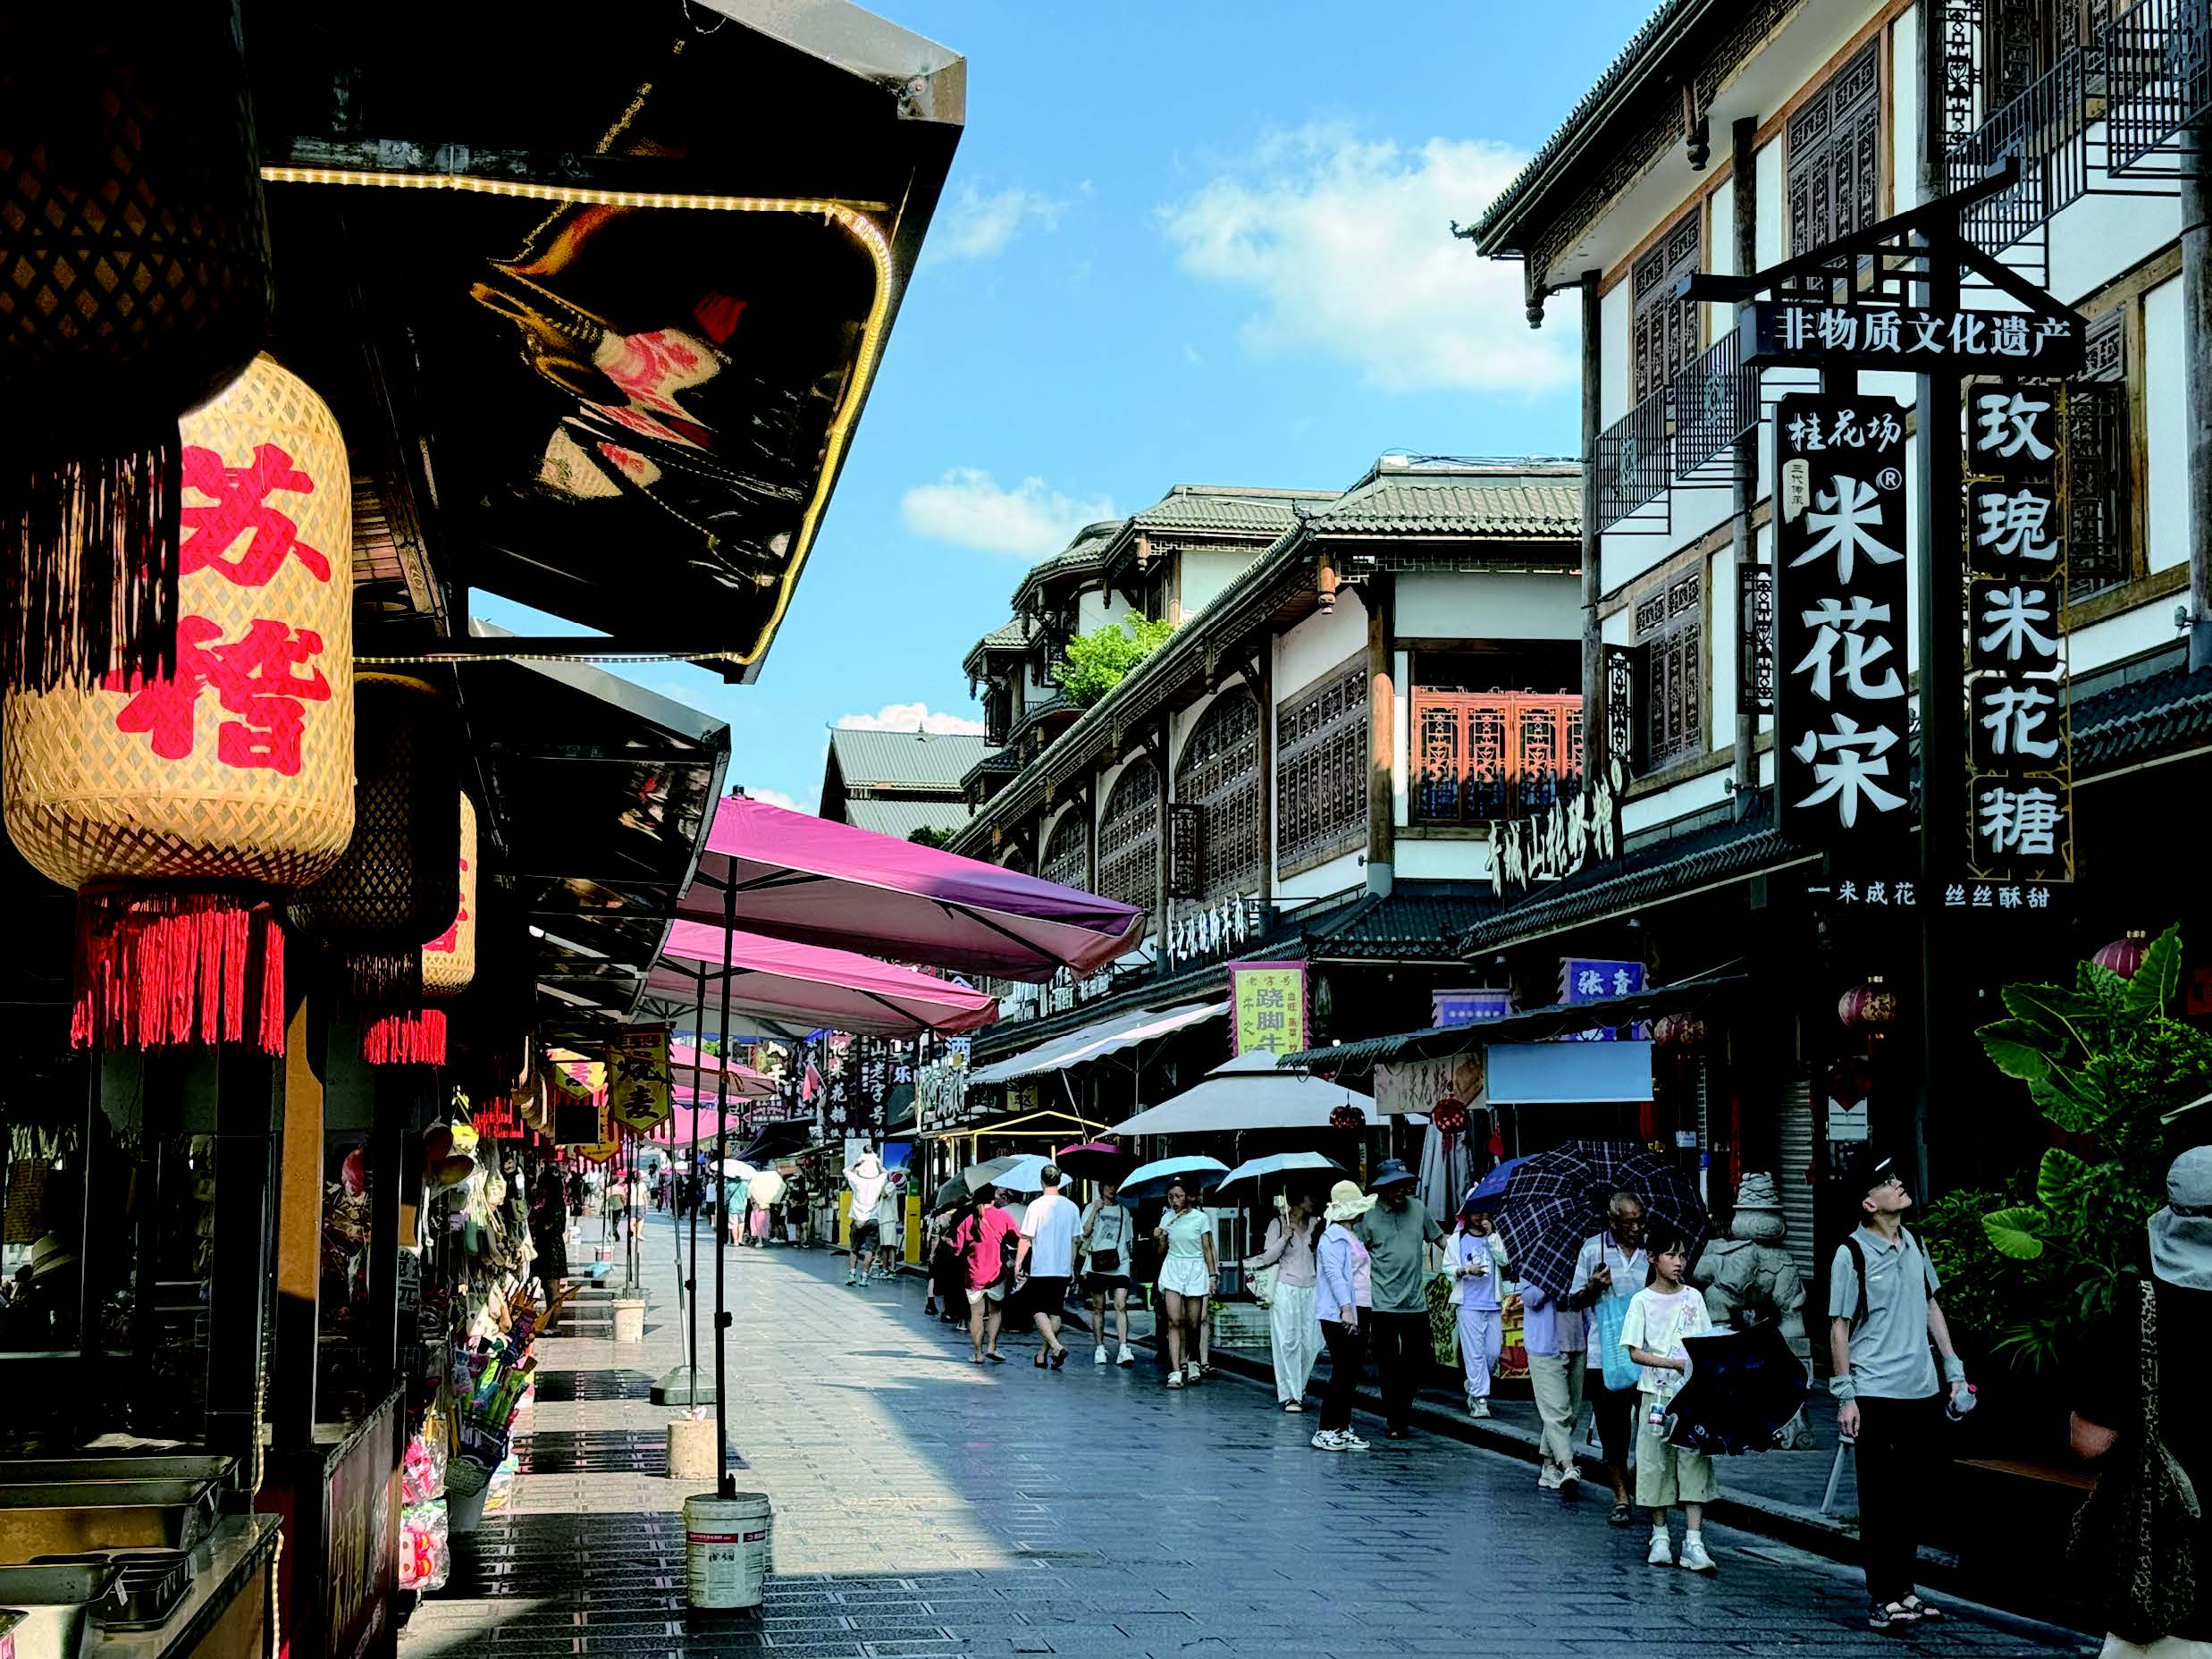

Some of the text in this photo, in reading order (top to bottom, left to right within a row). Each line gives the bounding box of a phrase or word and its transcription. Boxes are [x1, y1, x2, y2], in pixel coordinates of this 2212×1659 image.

[1775, 307, 2071, 357] 非物质文化遗产
[1787, 408, 1902, 453] 桂花场
[103, 442, 332, 777] 苏稽
[1788, 474, 1906, 830] 米花宋
[1976, 392, 2058, 855] 玫瑰米花糖
[1807, 880, 2050, 909] 一米成花 丝丝酥甜
[828, 1030, 849, 1123] 记米花糖
